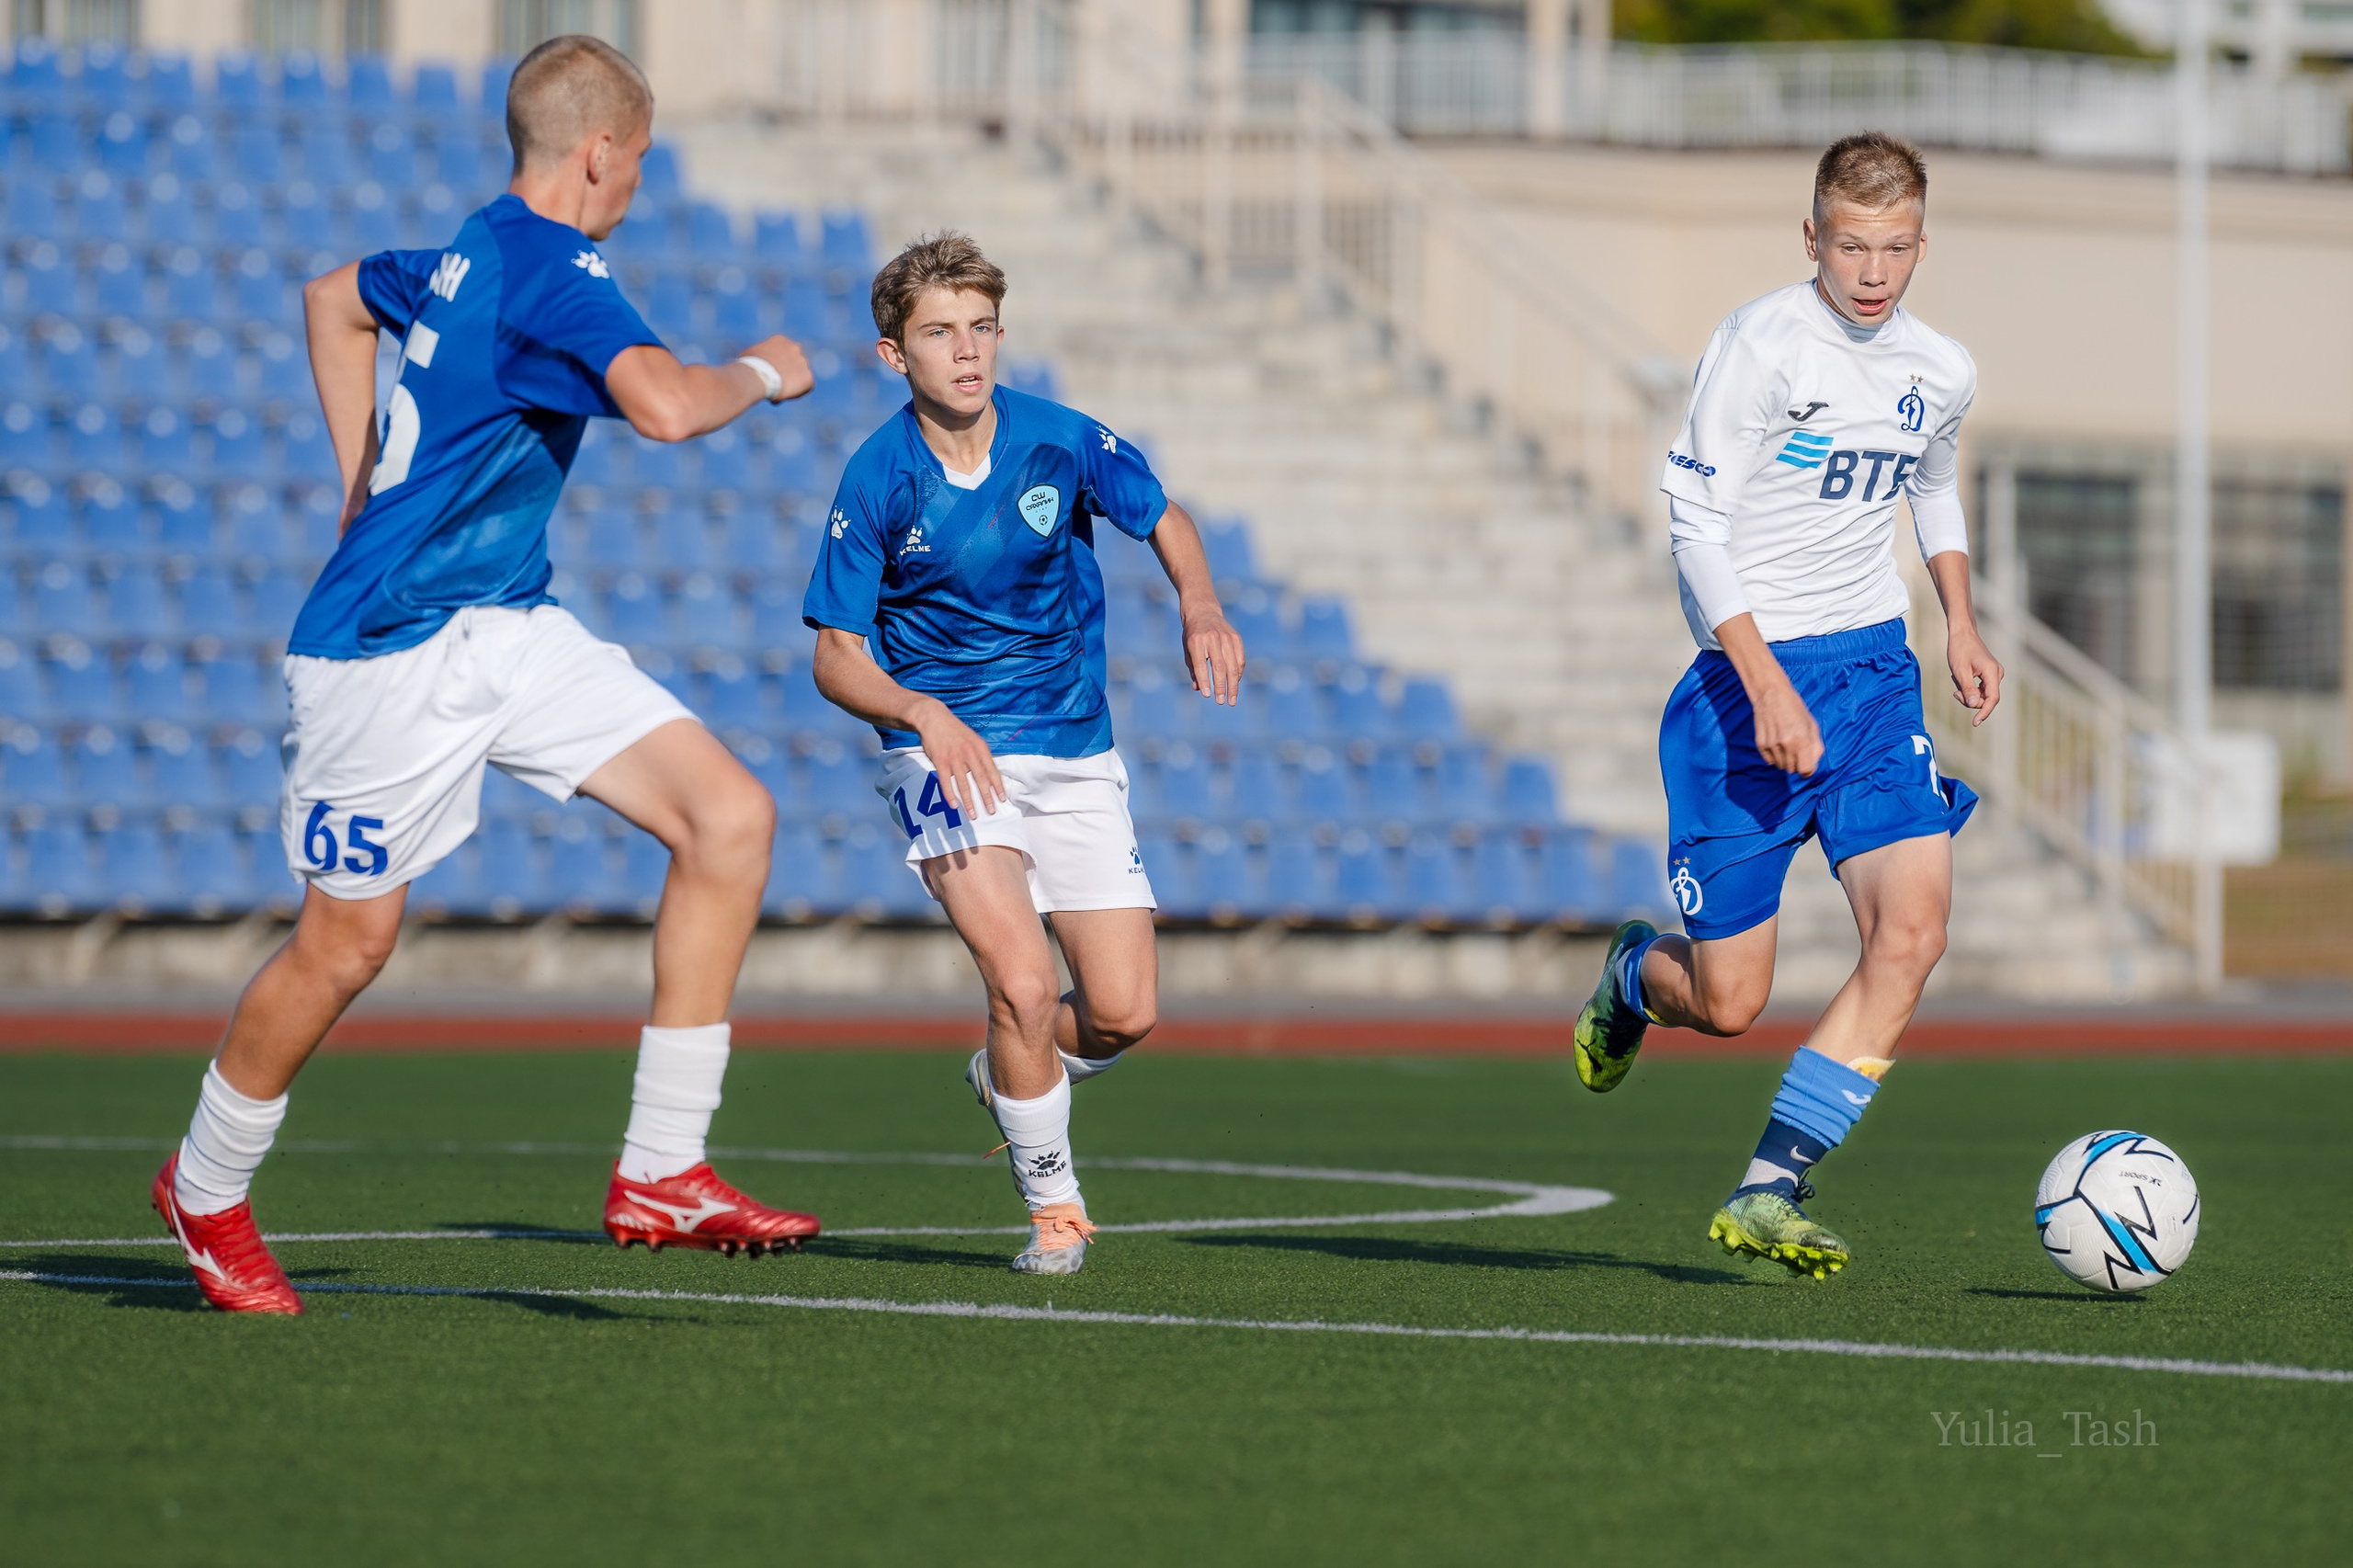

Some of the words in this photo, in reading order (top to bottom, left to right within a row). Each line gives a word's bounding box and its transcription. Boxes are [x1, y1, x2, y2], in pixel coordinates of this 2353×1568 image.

[899, 545, 931, 556] KELME
[894, 770, 962, 840] 14
[304, 800, 388, 876] 65
[1029, 1160, 1067, 1178] KELME
